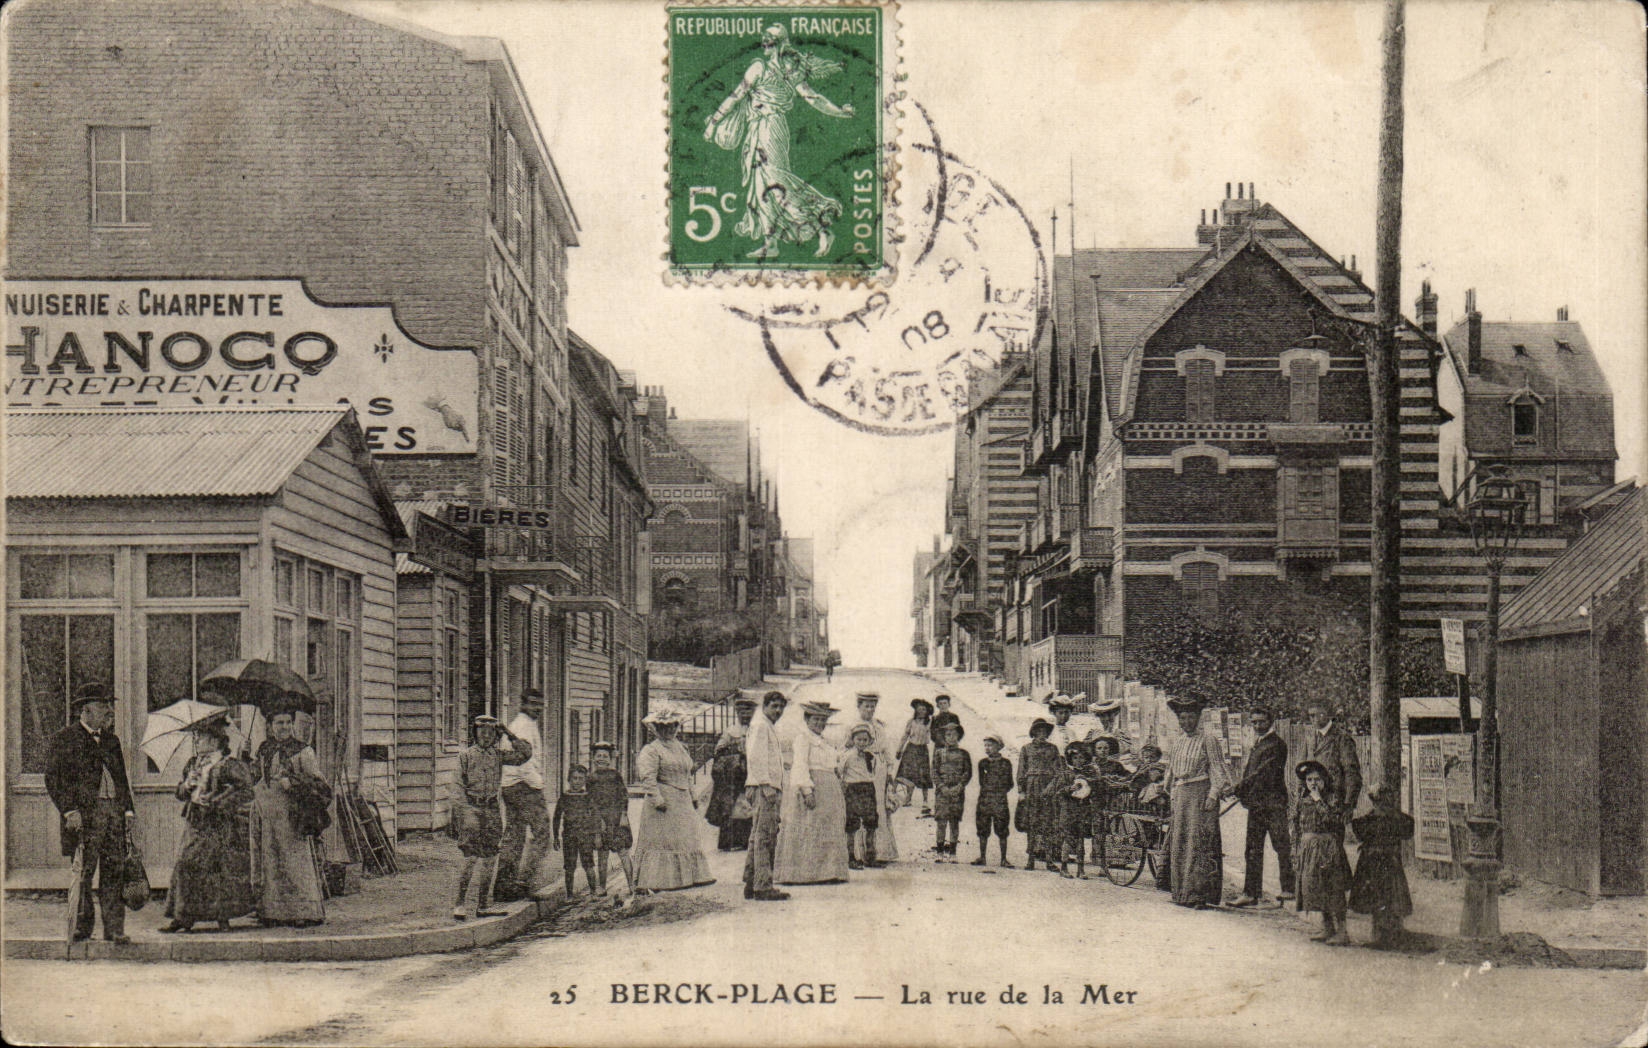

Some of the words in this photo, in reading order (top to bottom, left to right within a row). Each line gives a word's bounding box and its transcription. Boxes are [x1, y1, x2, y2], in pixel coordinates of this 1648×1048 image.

[790, 17, 873, 37] FRANÇAISE
[853, 168, 873, 255] POSTES
[117, 300, 130, 316] &
